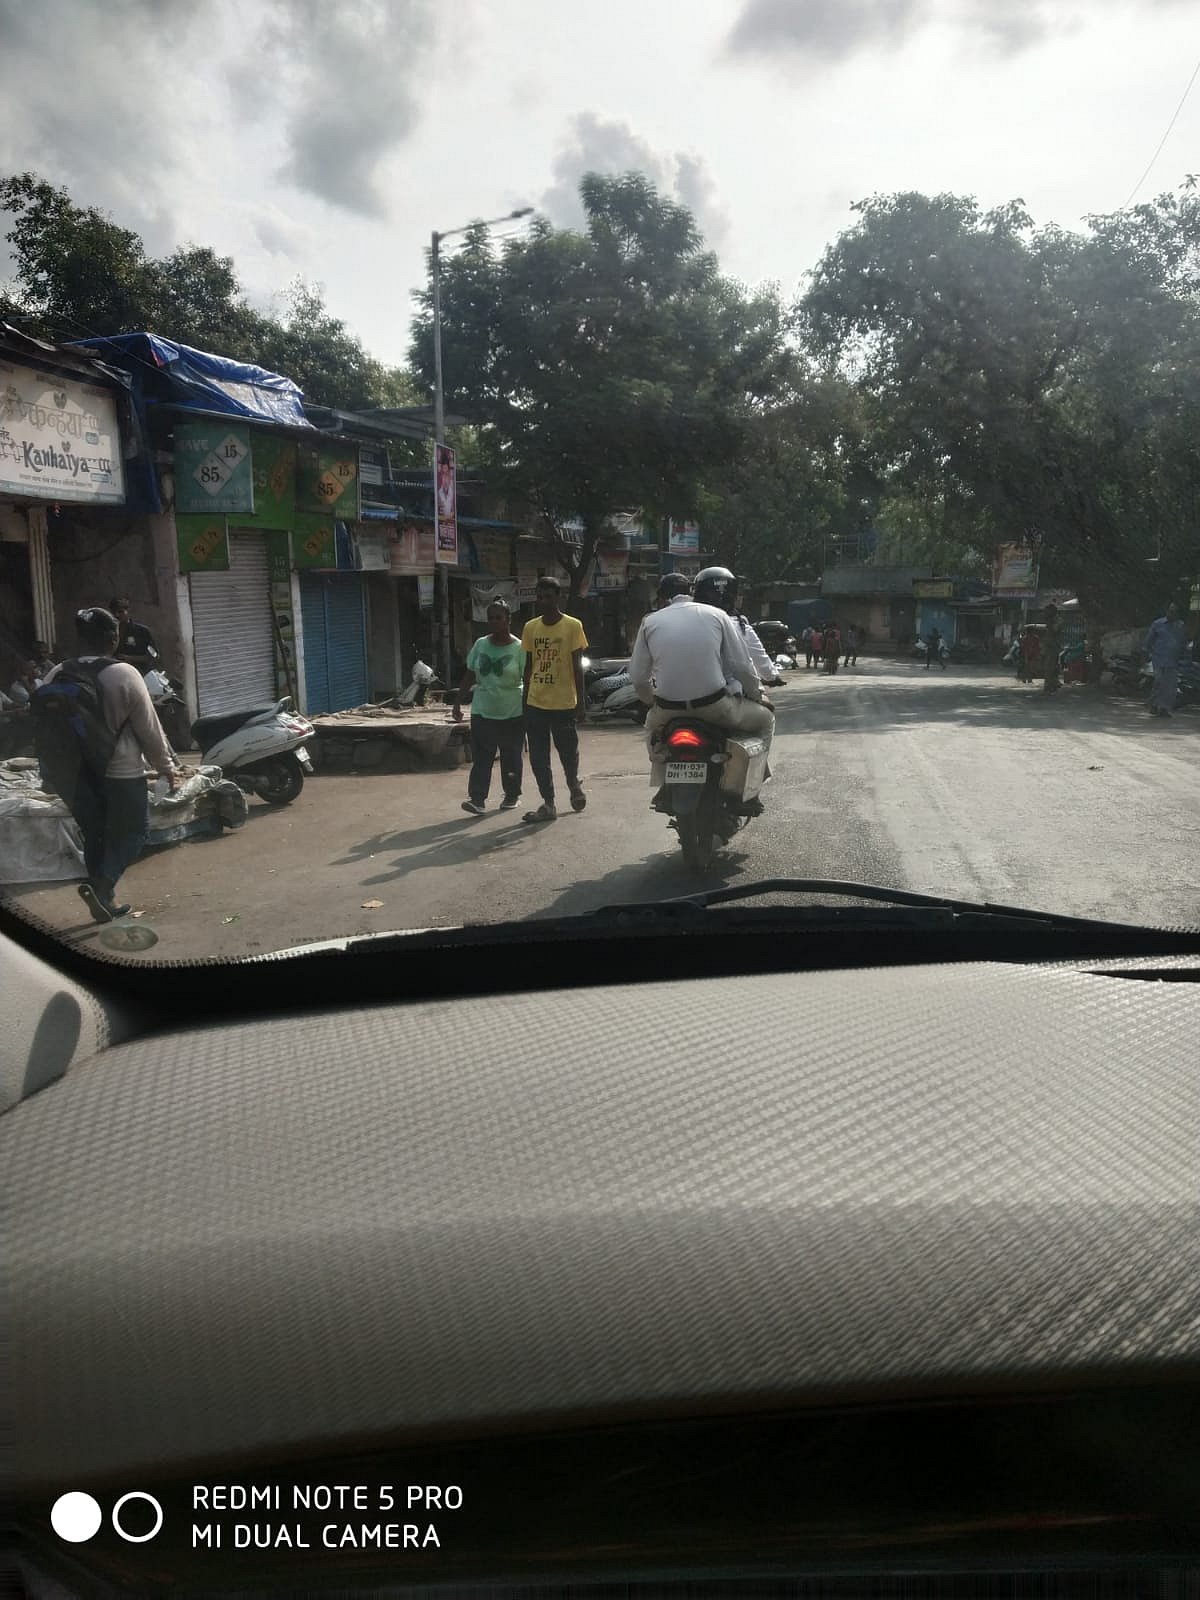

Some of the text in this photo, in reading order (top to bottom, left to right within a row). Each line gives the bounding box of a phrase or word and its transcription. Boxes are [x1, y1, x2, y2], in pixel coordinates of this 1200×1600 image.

[22, 440, 90, 478] Kanhaiya
[536, 649, 558, 661] STEP
[540, 661, 551, 673] UP
